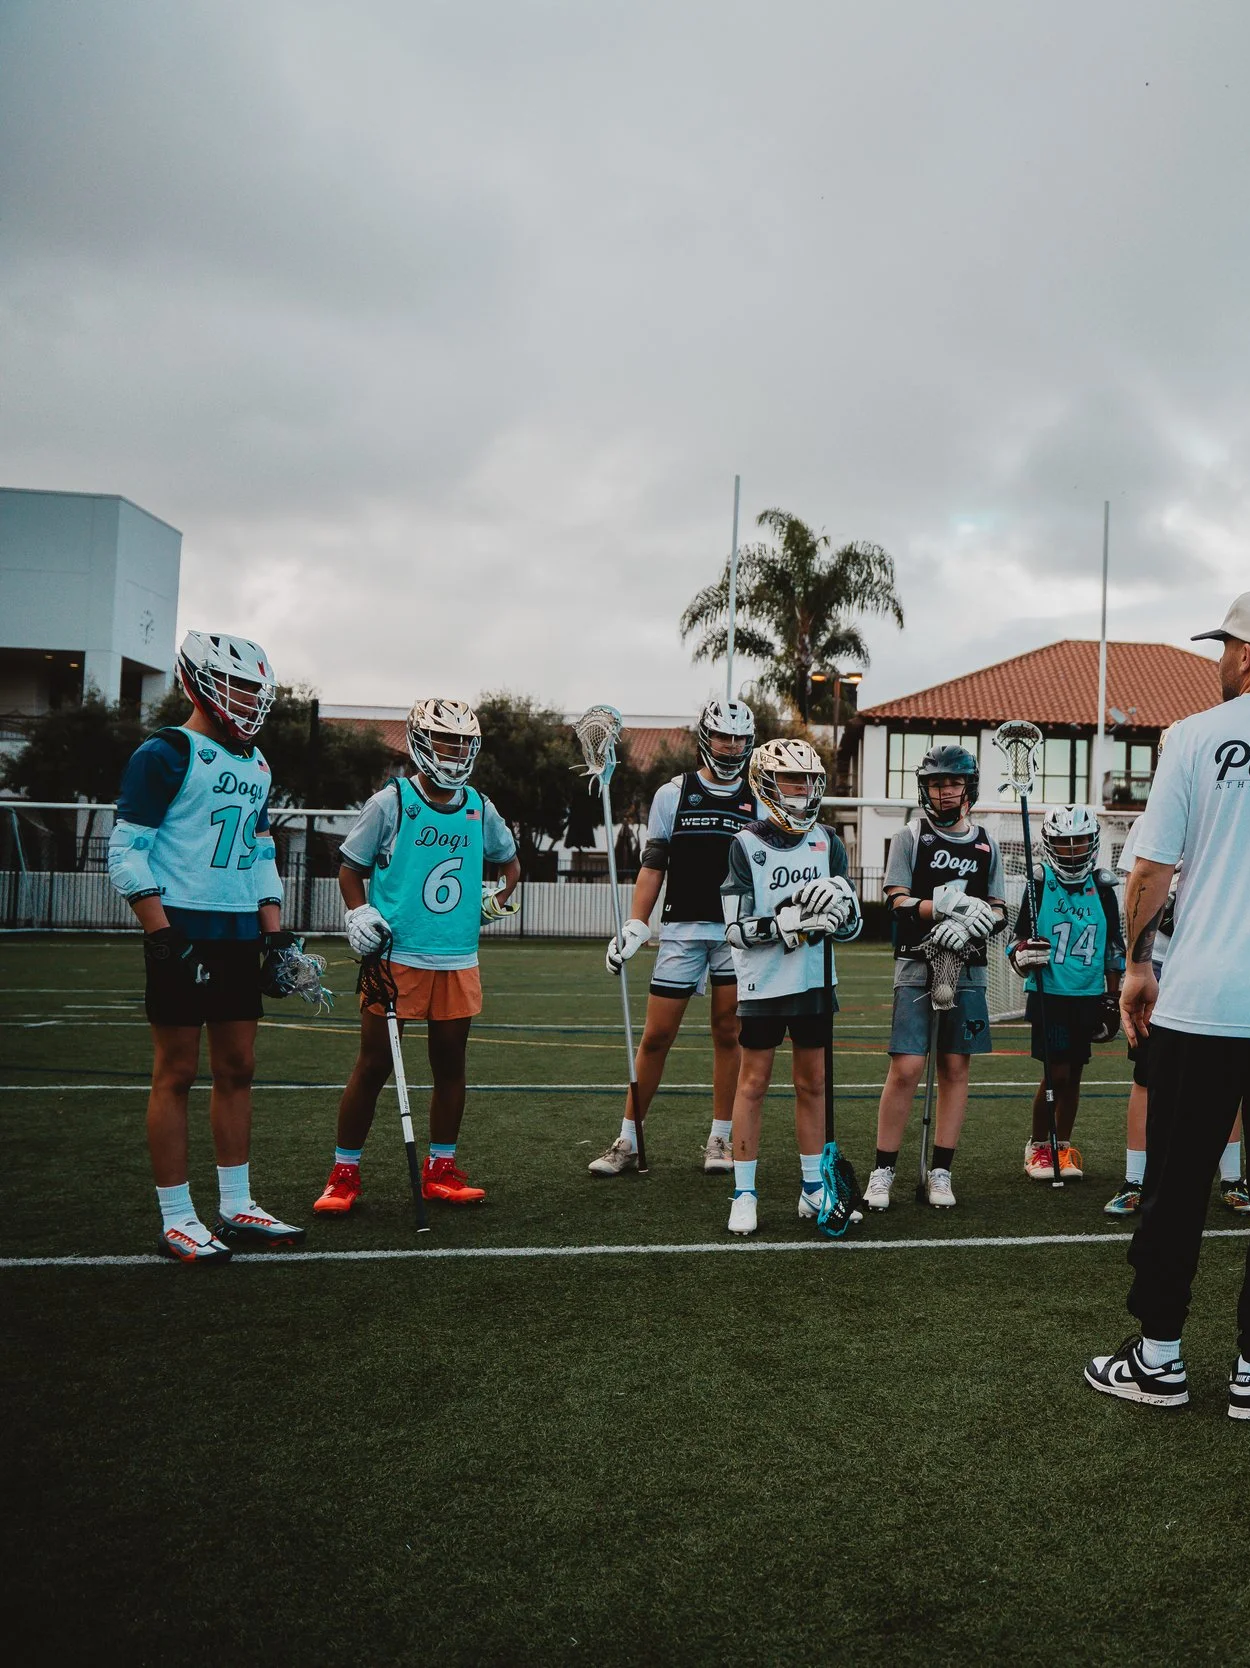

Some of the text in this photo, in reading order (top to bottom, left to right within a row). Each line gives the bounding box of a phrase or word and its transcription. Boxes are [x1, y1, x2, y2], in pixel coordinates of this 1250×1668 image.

[213, 771, 264, 804] Dogs
[681, 817, 719, 826] WEST
[210, 805, 258, 870] 19
[415, 826, 471, 853] Dogs
[930, 850, 978, 876] Dogs
[422, 857, 463, 914] 6
[769, 866, 821, 890] Dogs
[1052, 921, 1098, 966] 14
[1171, 1361, 1184, 1371] NIKE
